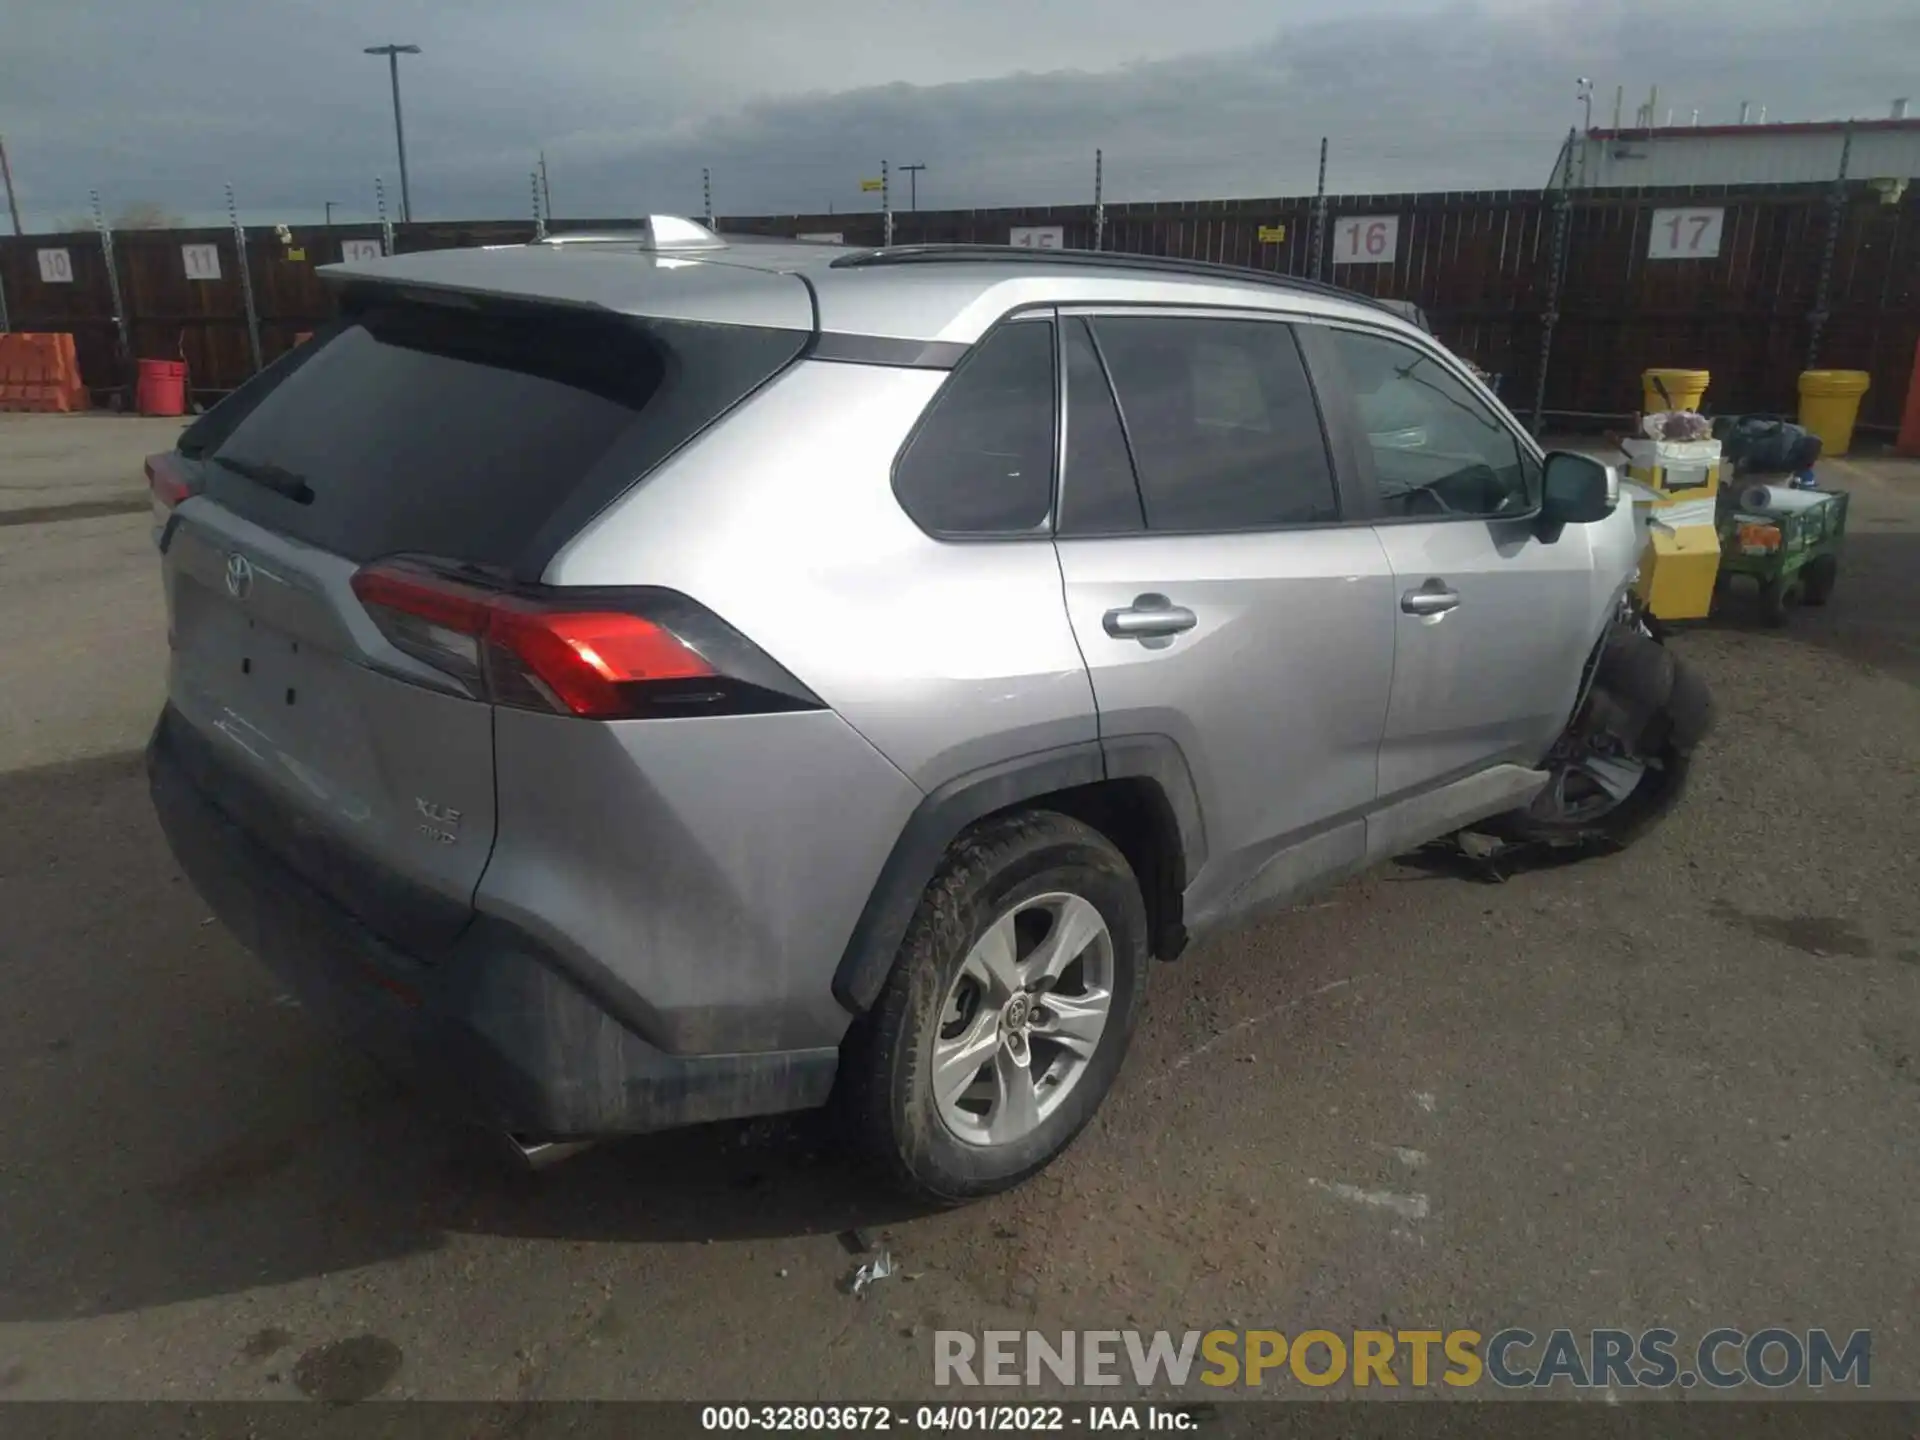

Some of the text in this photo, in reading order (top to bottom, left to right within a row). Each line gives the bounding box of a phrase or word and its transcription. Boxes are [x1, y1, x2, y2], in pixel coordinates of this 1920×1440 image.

[1347, 222, 1387, 256] 16
[1663, 215, 1713, 250] 17
[415, 796, 461, 825] XLE
